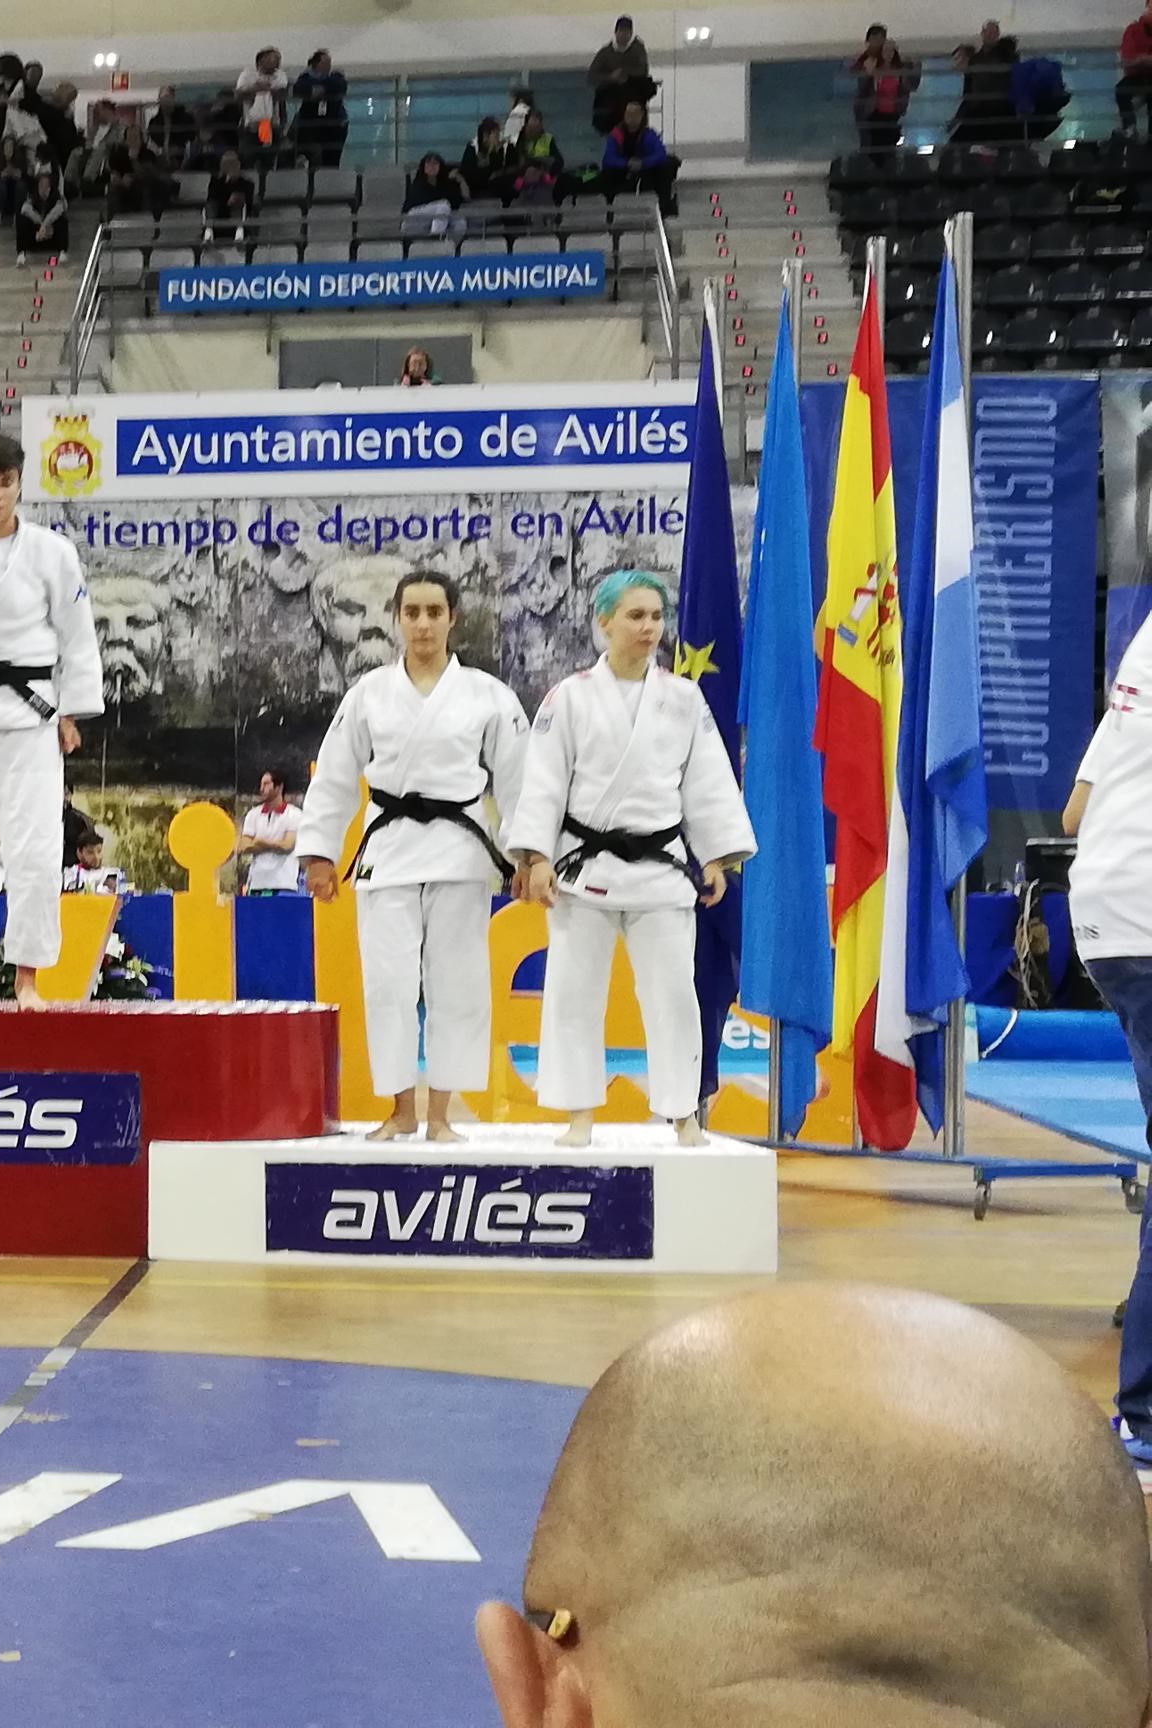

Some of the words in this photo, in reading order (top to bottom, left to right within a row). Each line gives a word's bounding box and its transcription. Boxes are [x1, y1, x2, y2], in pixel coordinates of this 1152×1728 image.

[168, 270, 310, 303] FUNDACIÓN
[320, 270, 455, 297] DEPORTIVA
[461, 263, 598, 291] MUNICIPAL
[132, 416, 465, 475] Ayuntamiento
[479, 411, 537, 456] de
[552, 409, 688, 457] Avilés
[84, 510, 237, 557] tiempo
[248, 504, 301, 547] de
[317, 503, 492, 553] deporte
[510, 511, 564, 538] en
[577, 497, 684, 537] Avilé
[323, 1175, 592, 1245] avilés
